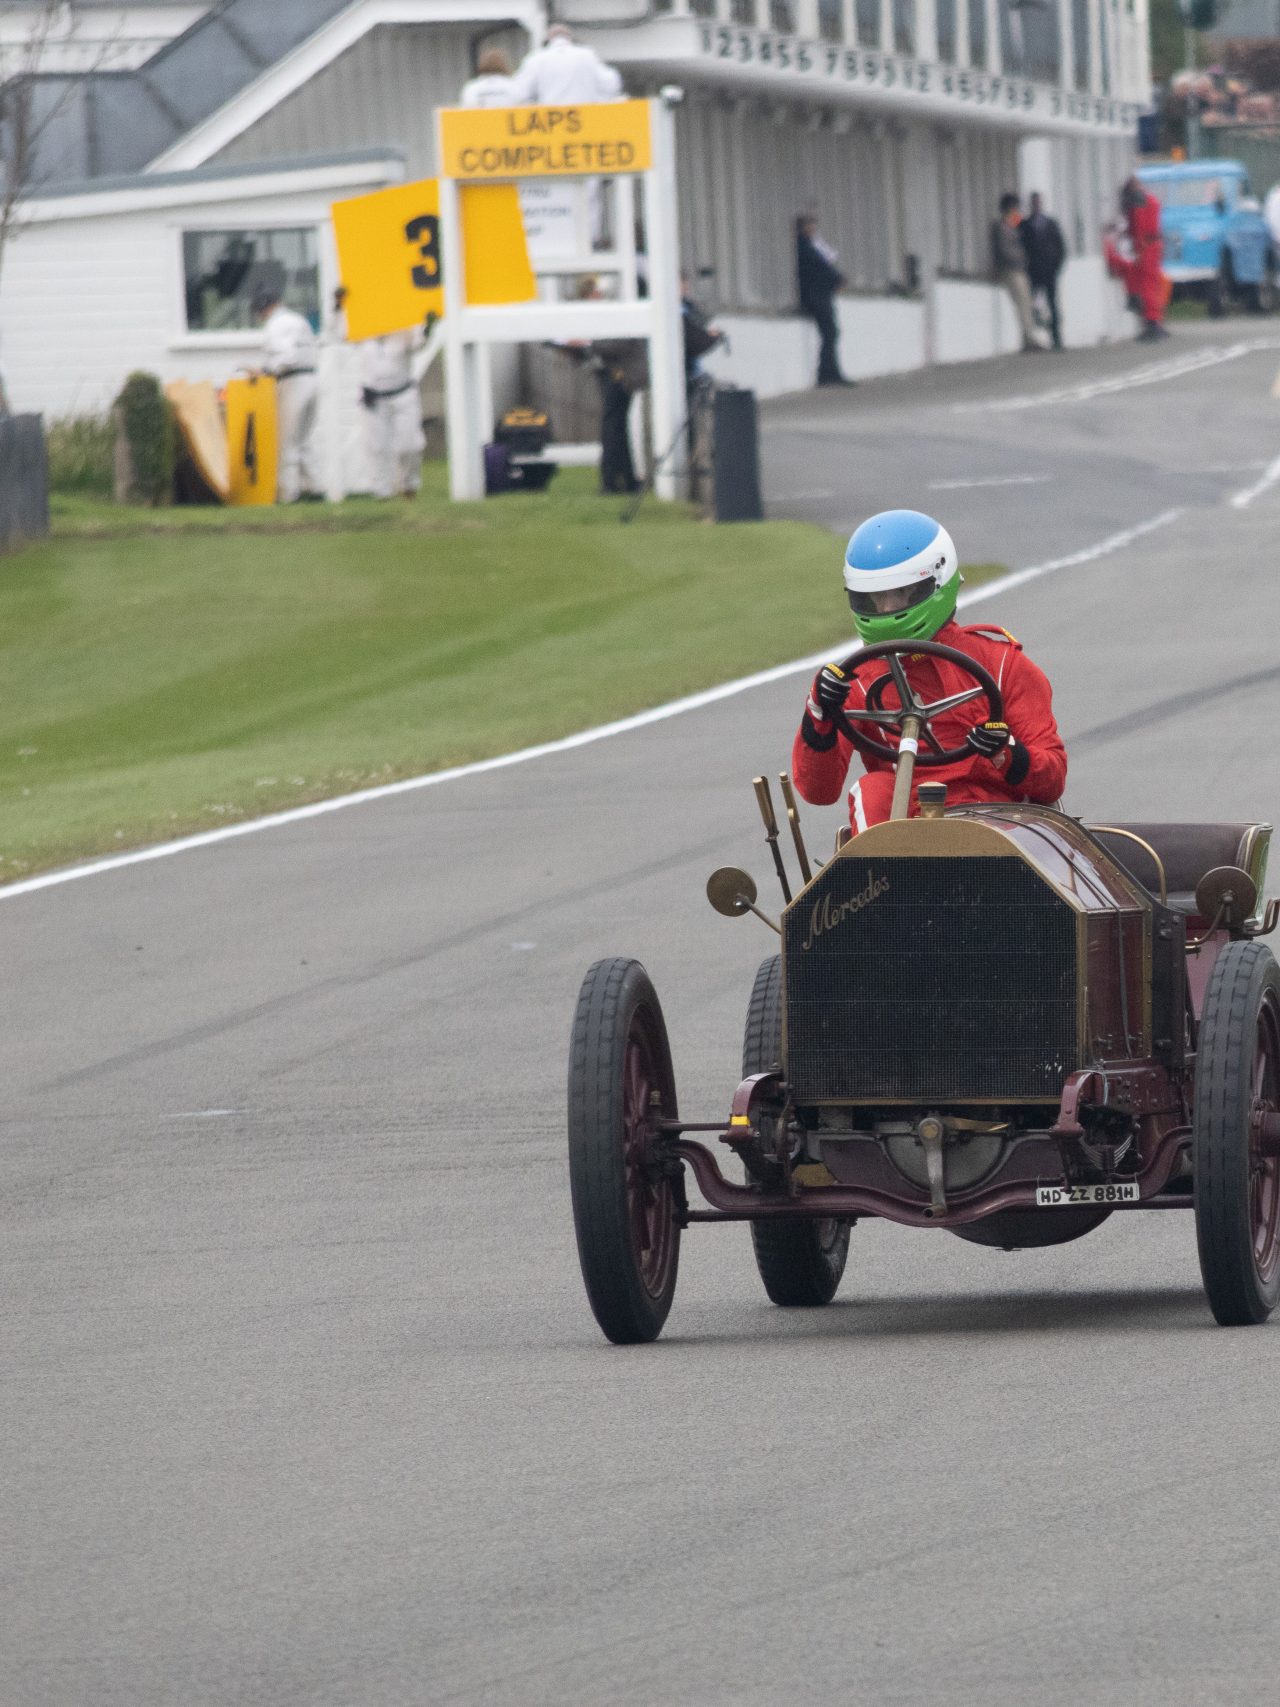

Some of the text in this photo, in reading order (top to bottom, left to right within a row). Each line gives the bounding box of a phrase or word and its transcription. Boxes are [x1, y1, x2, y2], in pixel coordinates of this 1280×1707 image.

[508, 109, 582, 136] LAPS
[459, 140, 635, 172] COMPLETED
[405, 214, 441, 289] 3
[803, 867, 890, 950] Mercedes
[1040, 1185, 1134, 1203] HD ZZ 881H
